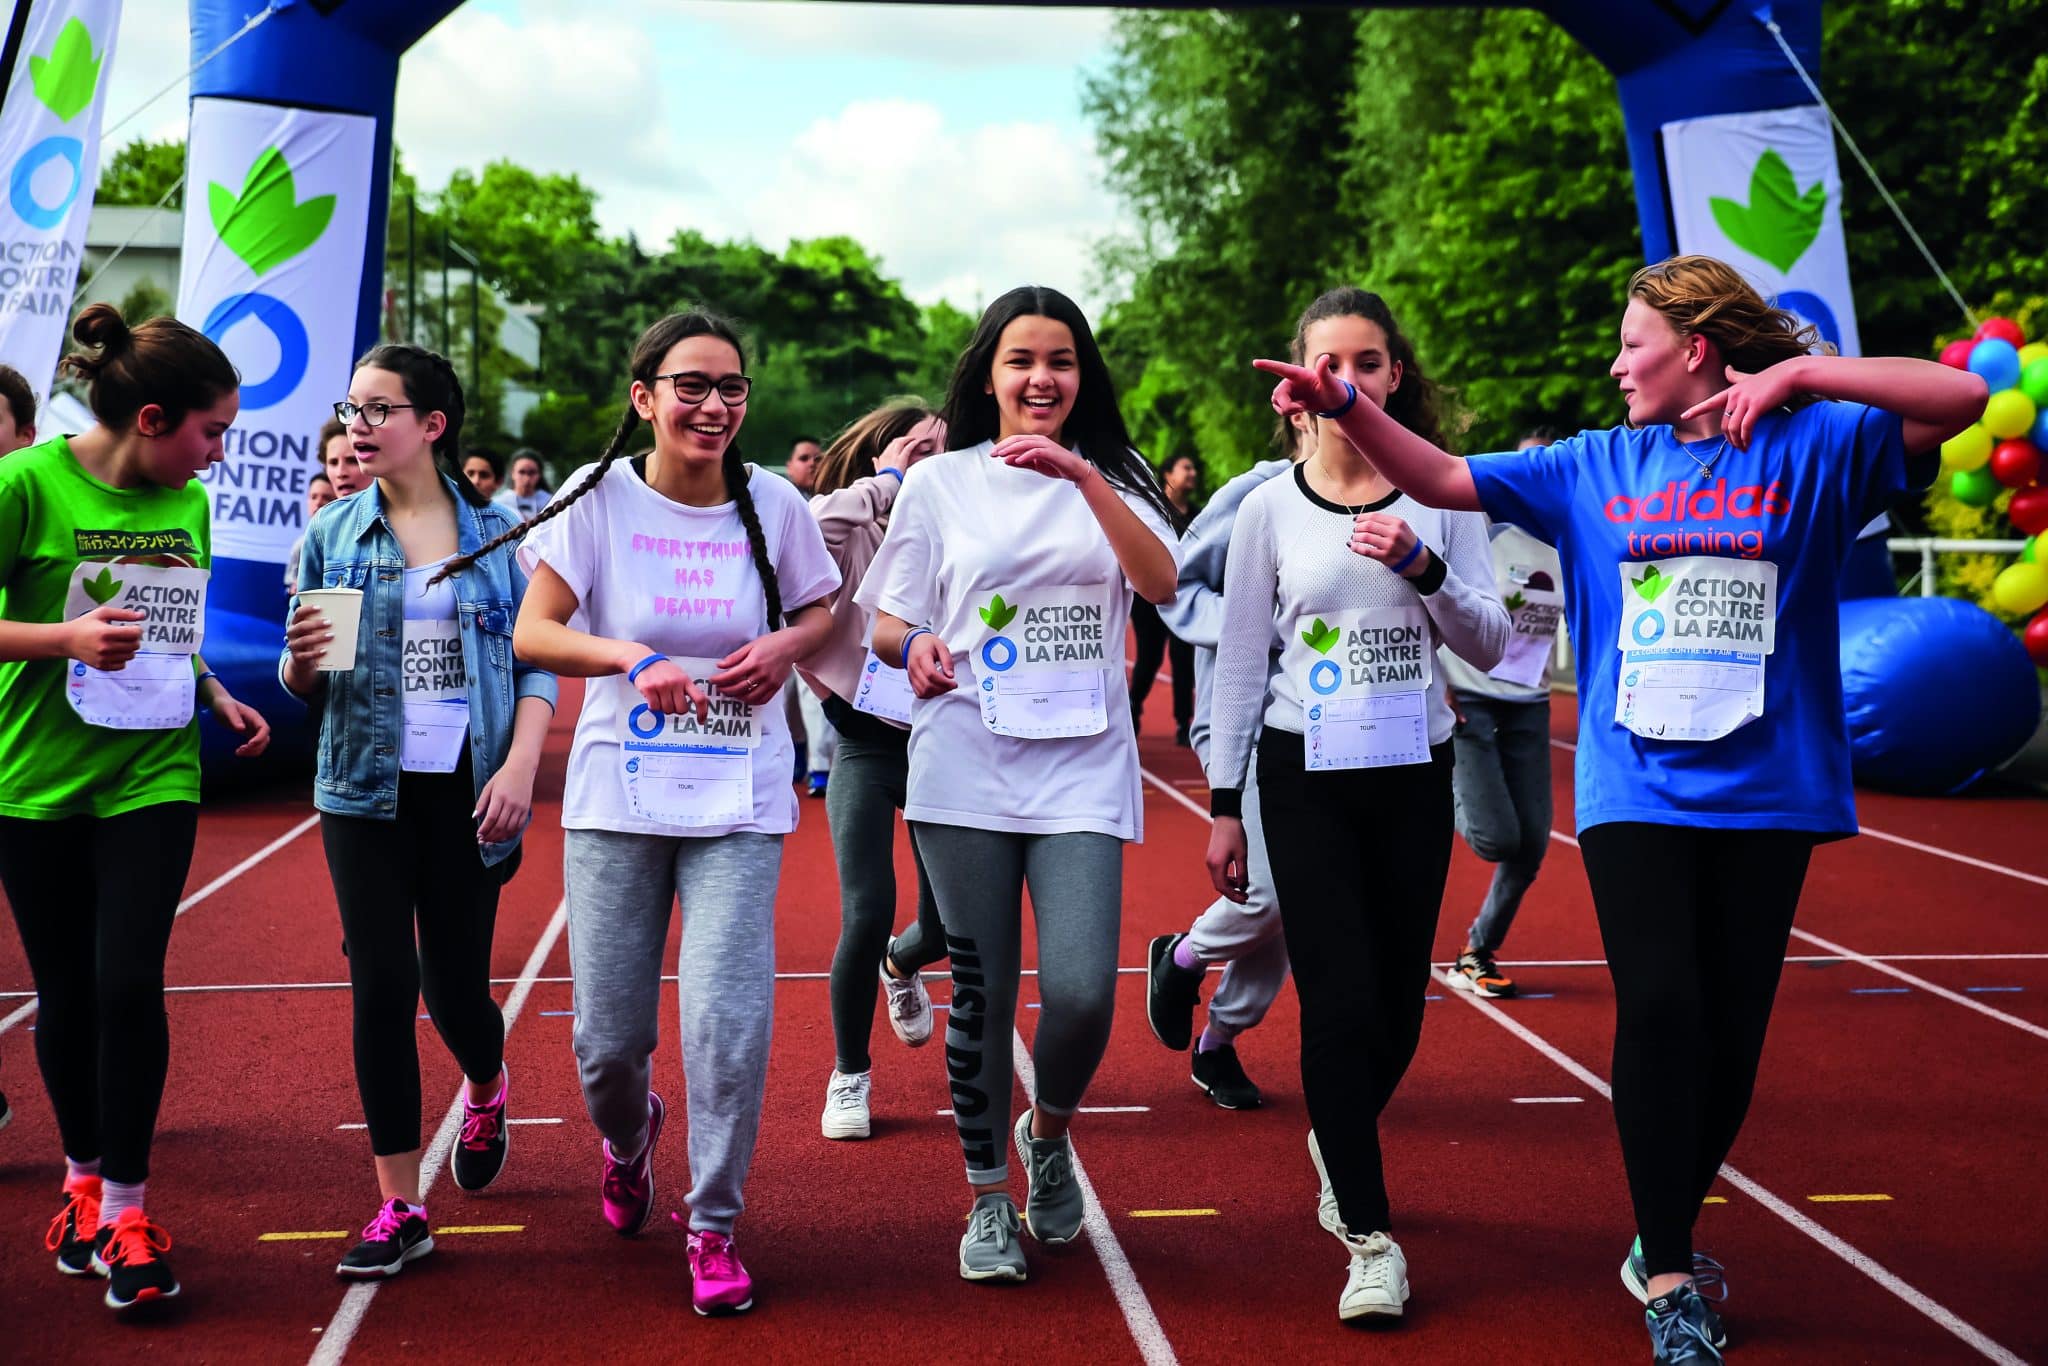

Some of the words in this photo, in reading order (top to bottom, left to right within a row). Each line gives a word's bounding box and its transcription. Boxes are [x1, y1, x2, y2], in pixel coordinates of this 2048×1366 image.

[224, 427, 309, 462] TION
[198, 461, 307, 494] NTRE
[215, 493, 303, 529] FAIM
[1603, 477, 1791, 523] adidas
[1627, 527, 1764, 559] training
[675, 567, 715, 591] HAS
[1676, 578, 1766, 601] ACTION
[124, 585, 200, 606] ACTION
[654, 596, 736, 620] BEAUTY
[1024, 604, 1101, 625] ACTION
[1675, 599, 1765, 621] CONTRE
[148, 624, 194, 644] FAIM
[1024, 624, 1103, 644] CONTRE
[1347, 625, 1422, 648] ACTION
[1674, 619, 1702, 637] LA
[1707, 619, 1764, 642] FAIM
[404, 639, 463, 655] ACTIO
[1025, 645, 1051, 663] LA
[1055, 642, 1104, 662] FAIM
[1348, 644, 1421, 666] CONTRE
[404, 656, 465, 674] CONTR
[1350, 667, 1375, 686] LA
[1377, 662, 1423, 683] FAIM
[404, 675, 429, 692] LA
[687, 698, 753, 718] NTRE
[673, 716, 699, 734] LA
[703, 718, 752, 738] FAIM
[945, 1044, 990, 1118] DO
[956, 1128, 996, 1171] IT
